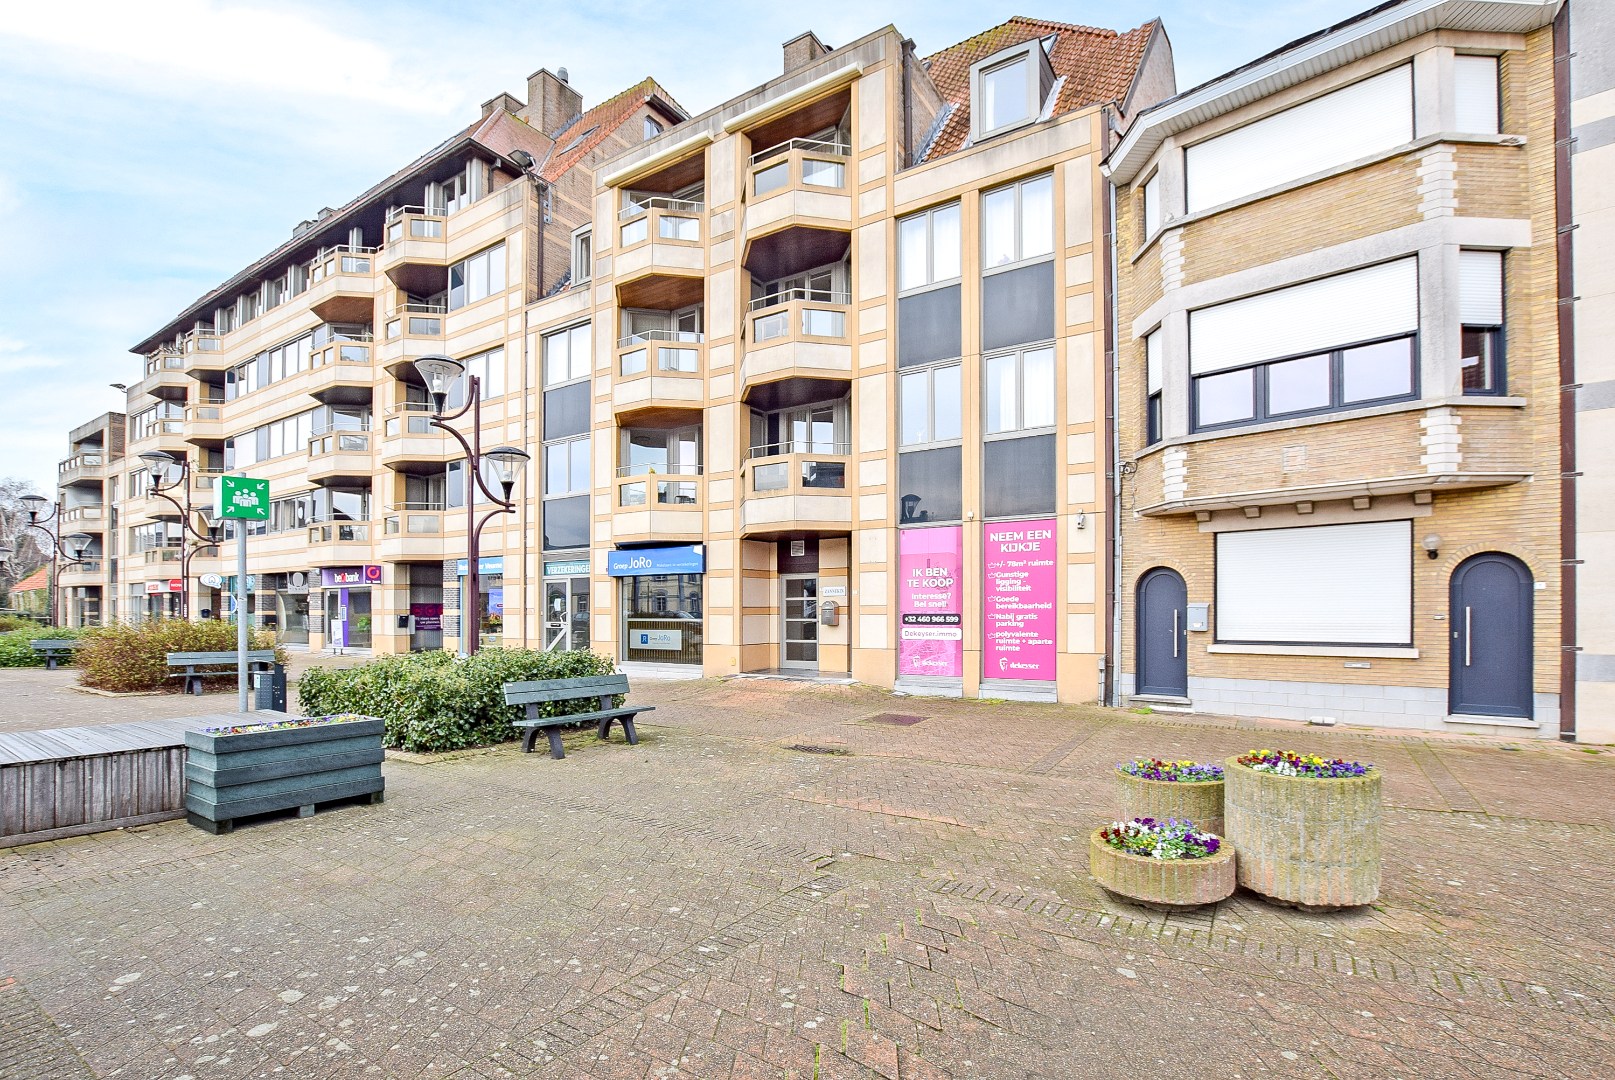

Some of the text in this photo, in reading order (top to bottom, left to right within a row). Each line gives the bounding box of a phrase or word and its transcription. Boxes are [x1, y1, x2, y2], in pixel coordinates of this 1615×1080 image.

[990, 530, 1052, 541] NEEM EEN
[1000, 542, 1041, 552] KIJKJE
[613, 556, 652, 570] Groep JoRo
[1028, 559, 1054, 567] ruimte
[912, 567, 948, 577] IK BEN
[996, 570, 1029, 578] Gunstige
[906, 577, 954, 588] TE KOOP
[996, 584, 1032, 592] visibiliteit
[911, 592, 951, 600] Interesse?
[996, 595, 1020, 603] Goede
[995, 602, 1053, 610] bereikbaarheid
[996, 612, 1038, 622] Nabij gratis
[995, 620, 1025, 628] parking
[904, 630, 958, 638] Dekeyser.immo
